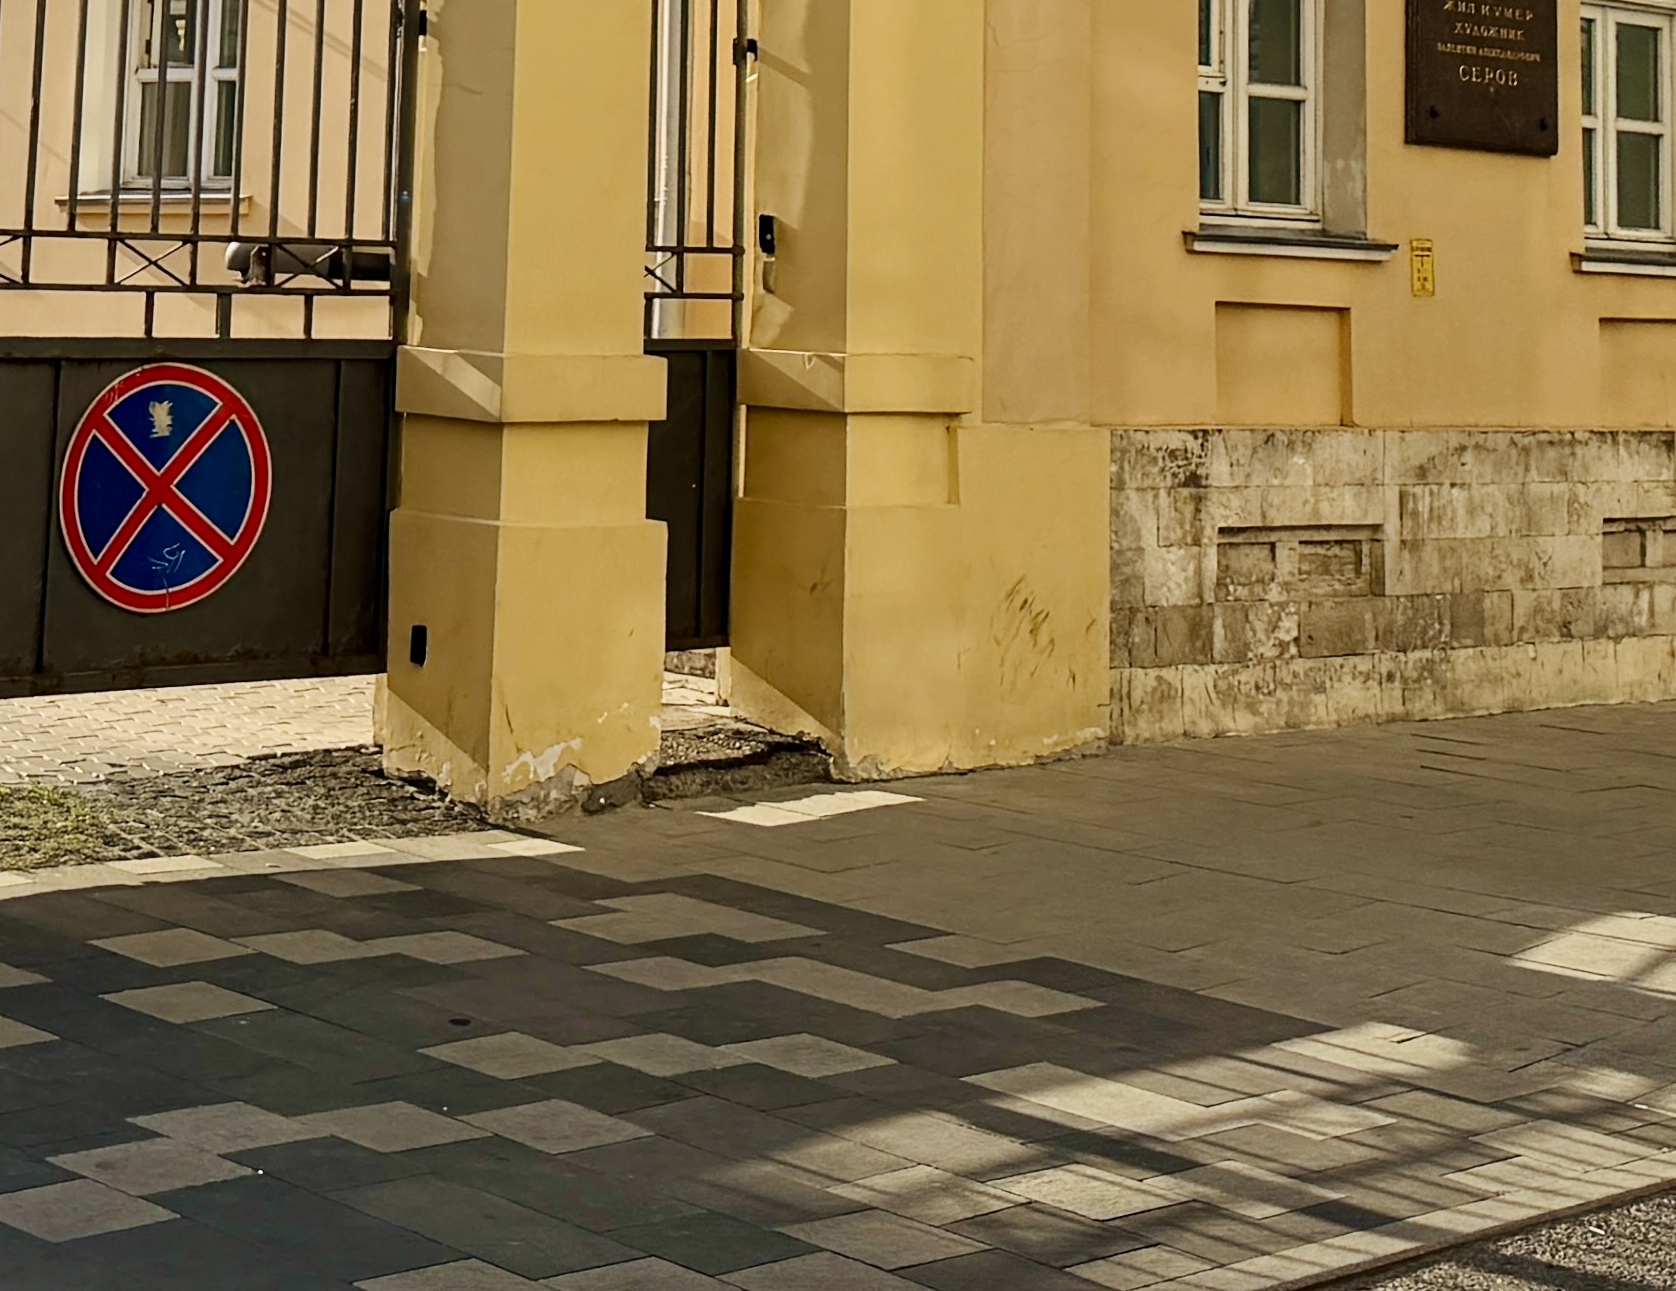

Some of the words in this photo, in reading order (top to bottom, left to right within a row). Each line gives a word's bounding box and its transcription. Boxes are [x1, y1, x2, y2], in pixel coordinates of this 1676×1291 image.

[1443, 0, 1475, 15] ЖИЛ
[1481, 4, 1490, 16] И
[1493, 6, 1534, 21] УМЕР
[1454, 22, 1525, 41] ХУДОЖНИК
[1459, 65, 1518, 86] СЕРОВ
